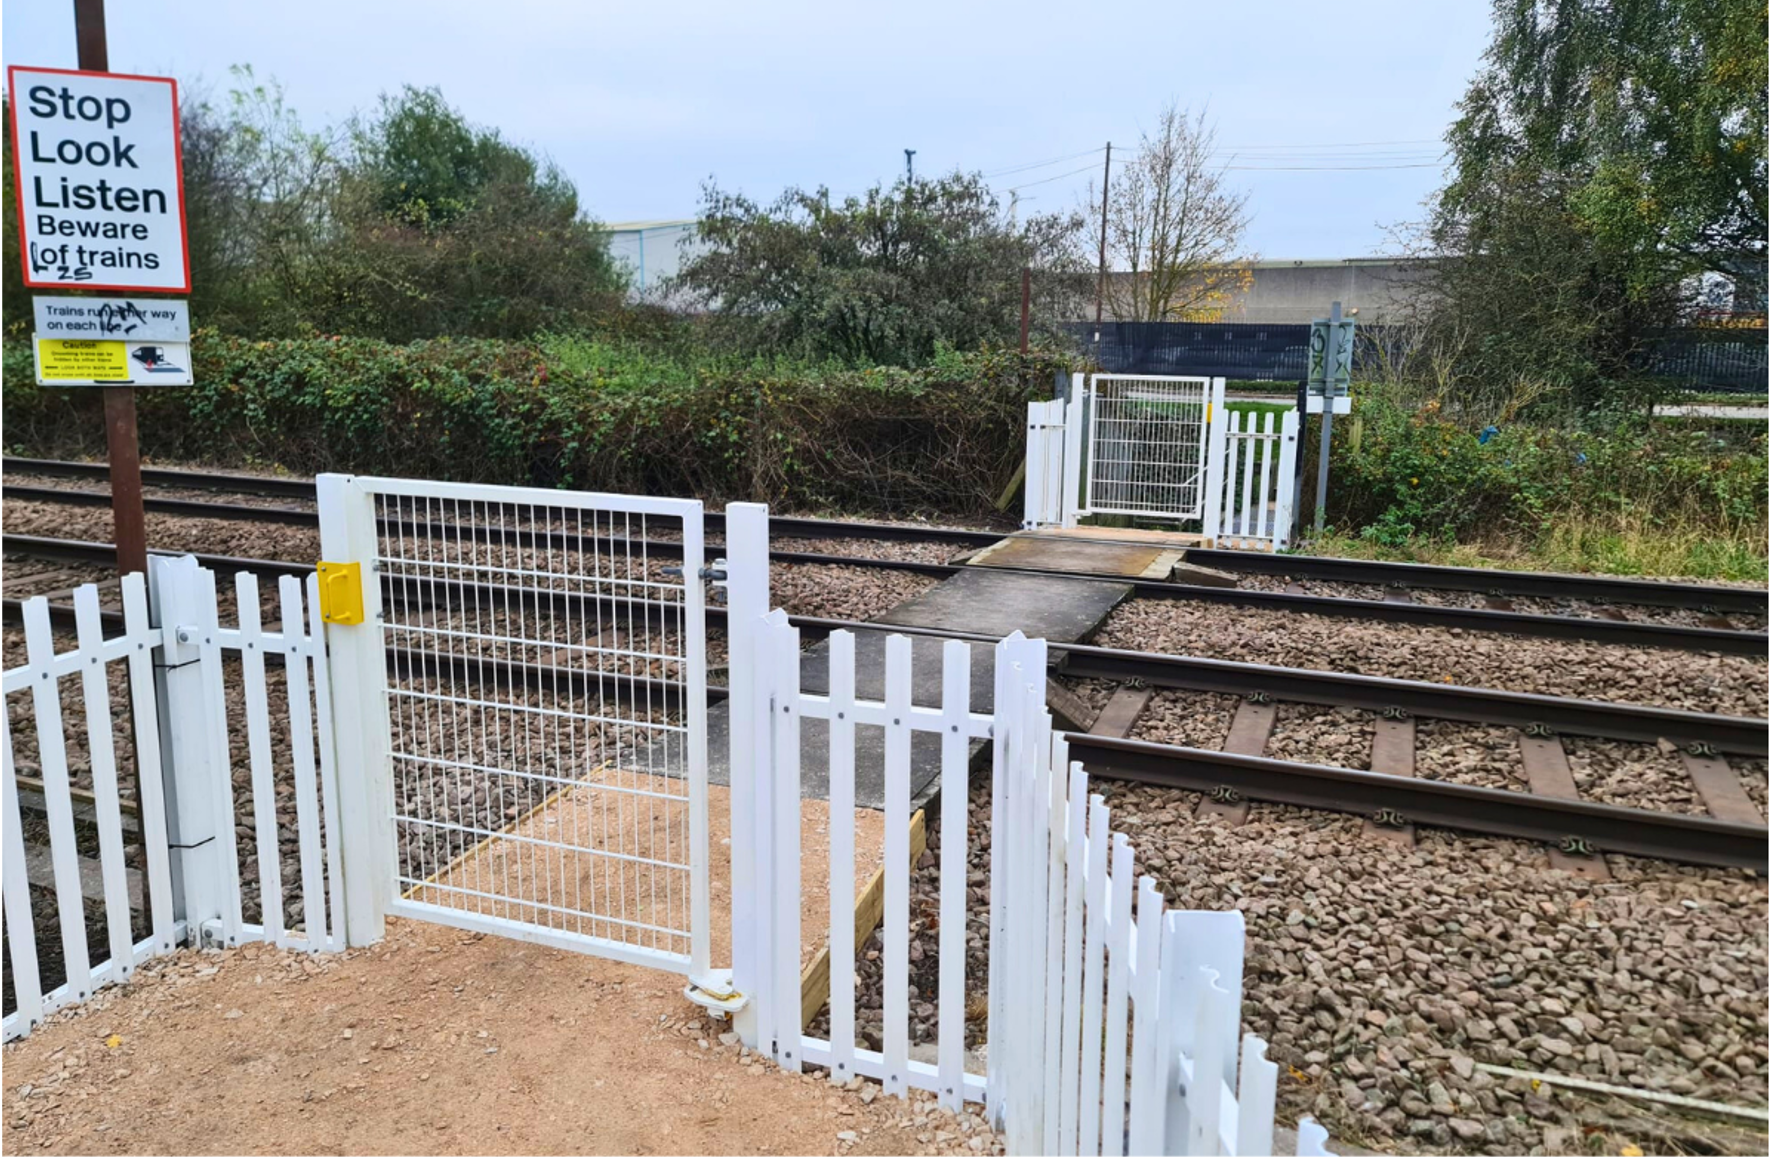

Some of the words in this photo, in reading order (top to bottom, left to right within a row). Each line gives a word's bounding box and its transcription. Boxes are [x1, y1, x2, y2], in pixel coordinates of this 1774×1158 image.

[28, 85, 132, 129] Stop
[30, 130, 140, 169] Look
[33, 175, 168, 214] Listen
[37, 214, 149, 241] Beware
[40, 244, 68, 265] of
[76, 245, 160, 270] trains
[46, 305, 85, 317] Trains
[150, 309, 177, 321] way
[46, 320, 63, 331] on
[66, 320, 98, 331] each
[62, 340, 98, 350] Caution
